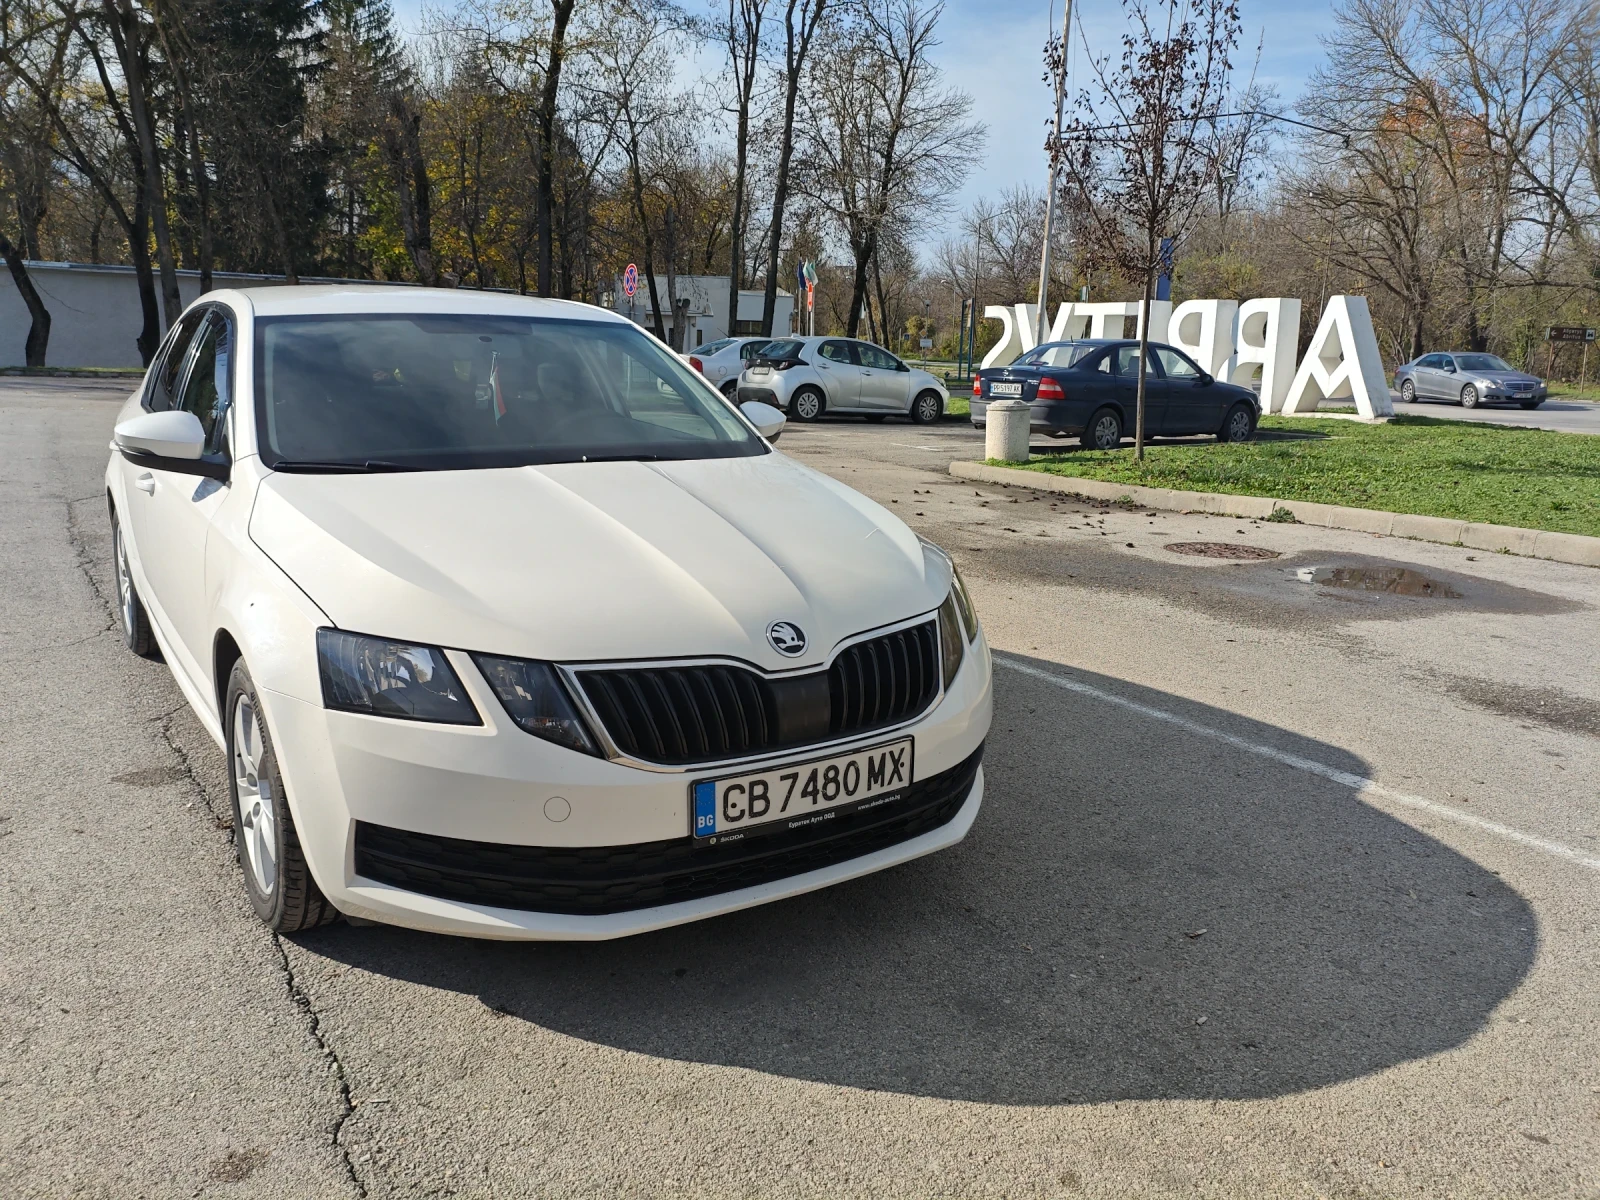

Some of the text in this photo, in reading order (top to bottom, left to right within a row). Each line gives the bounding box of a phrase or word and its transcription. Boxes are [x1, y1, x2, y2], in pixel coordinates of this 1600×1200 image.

[723, 747, 906, 823] CB 7480 MX
[857, 793, 901, 811] www.skoda-auto.bg
[697, 814, 714, 828] BG
